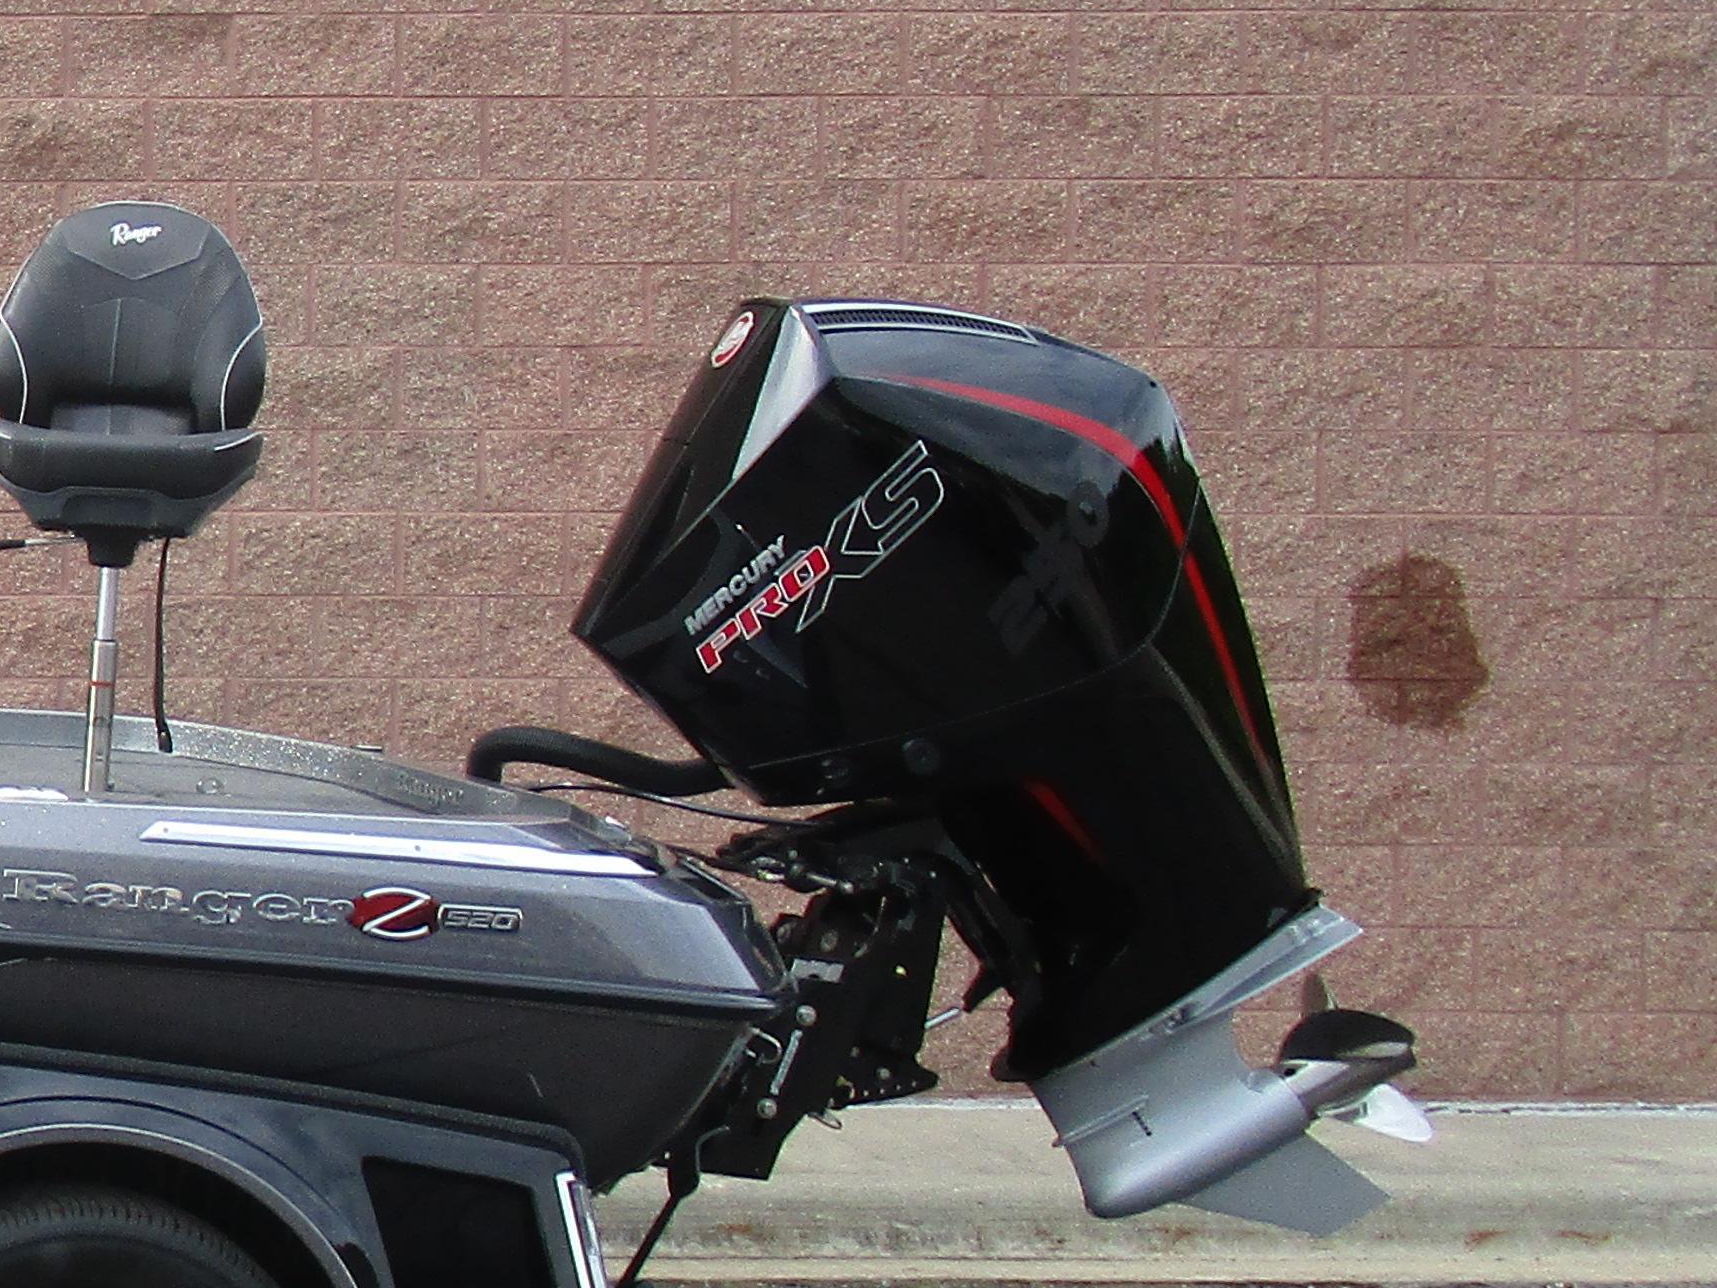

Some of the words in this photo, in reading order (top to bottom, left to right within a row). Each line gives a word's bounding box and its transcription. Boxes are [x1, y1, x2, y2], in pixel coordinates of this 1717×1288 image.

[110, 222, 162, 246] Ranger
[684, 534, 787, 636] MERCURY
[696, 544, 831, 674] PRO
[795, 438, 946, 634] XS
[2, 868, 355, 926] Ranger
[444, 910, 518, 931] 520
